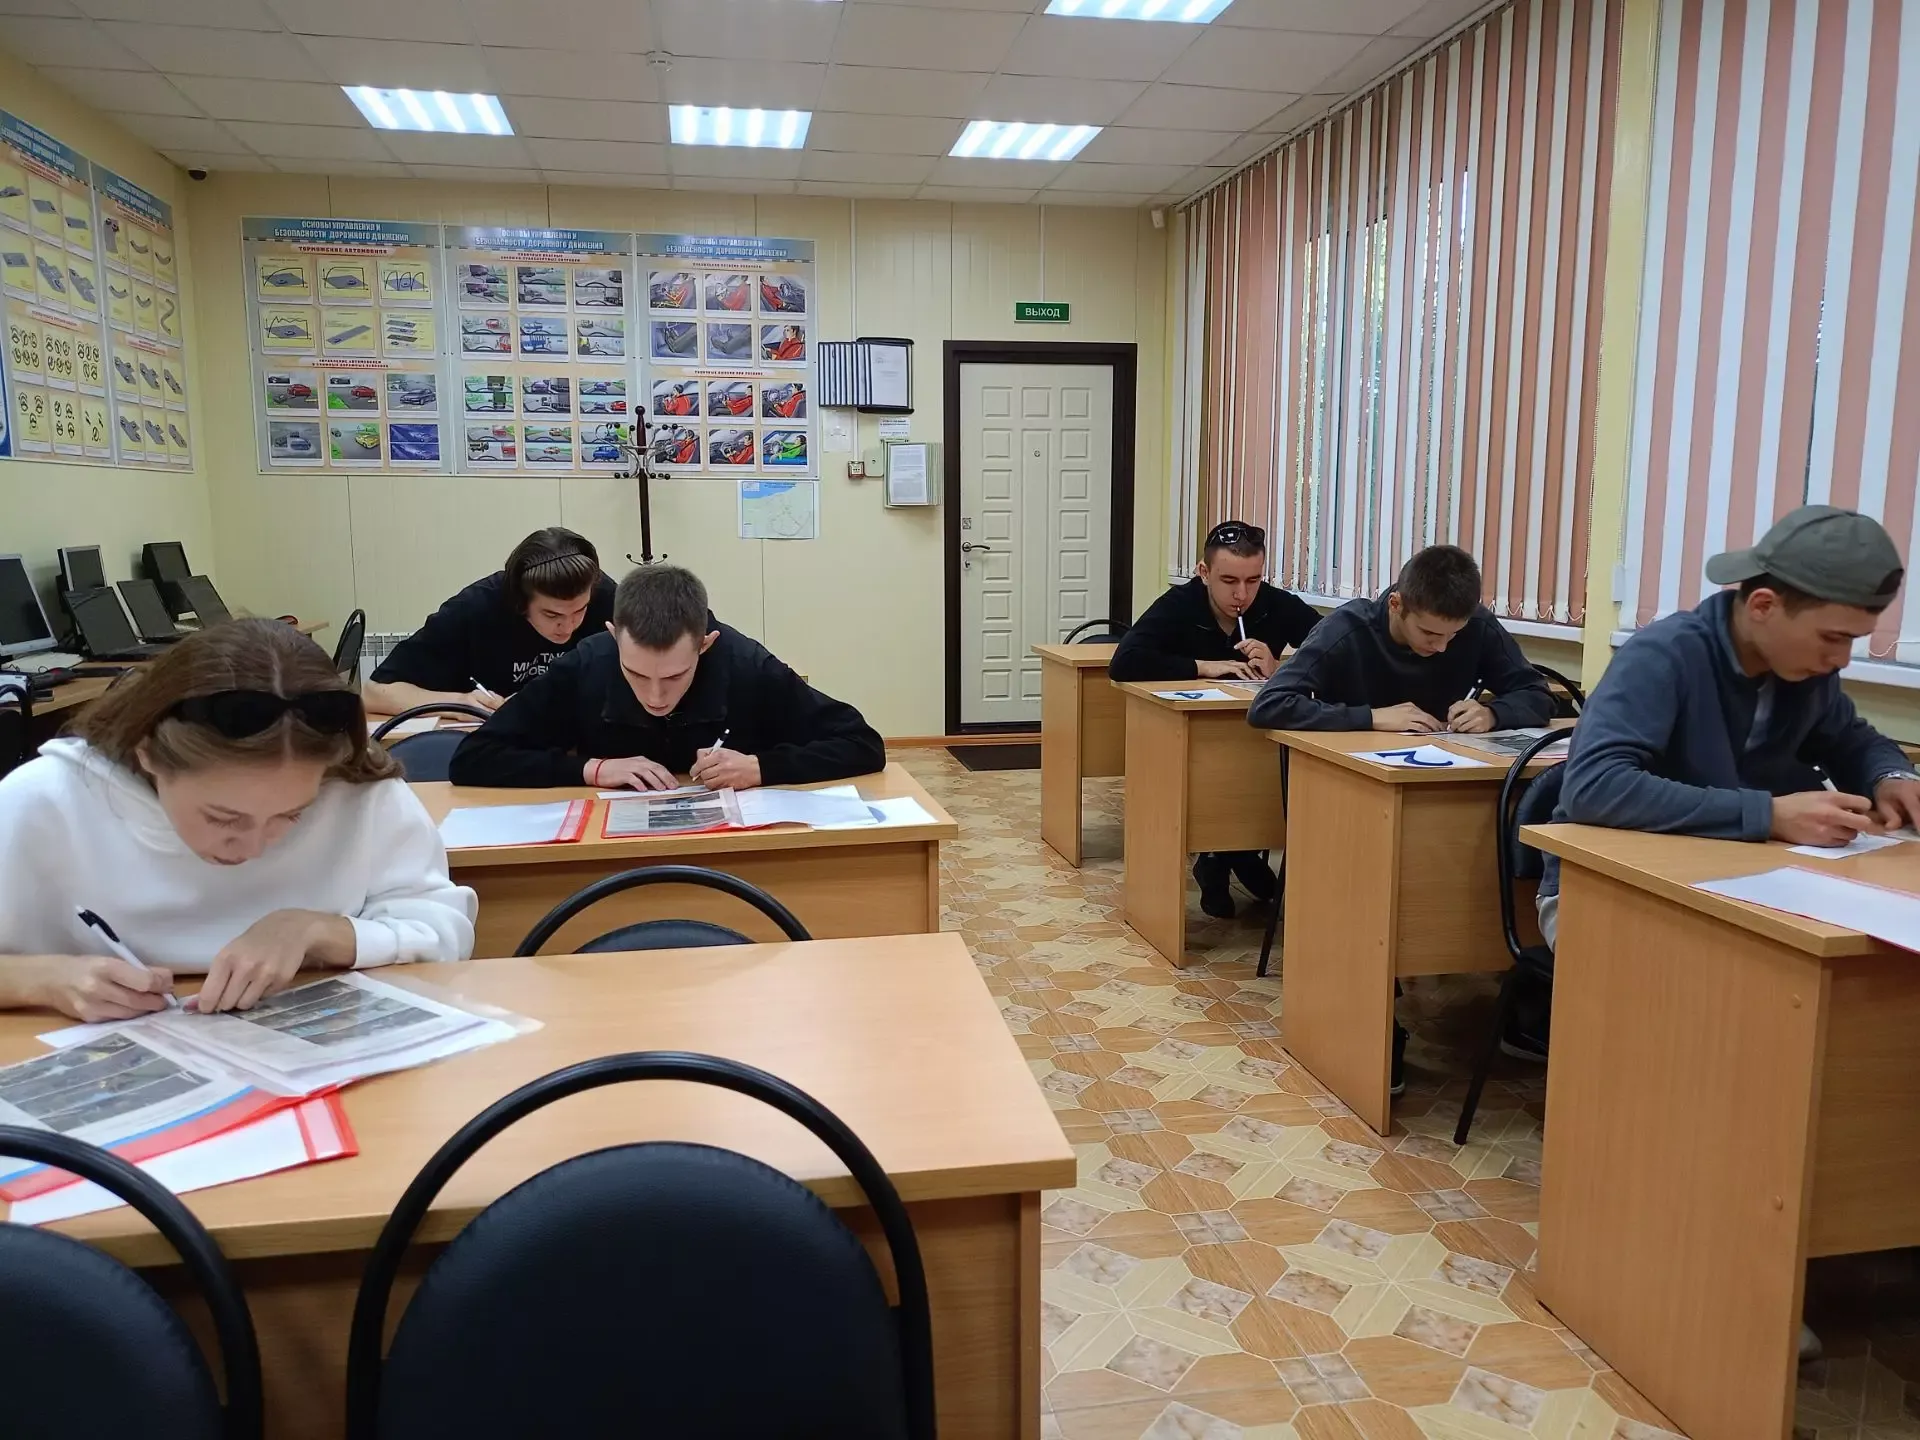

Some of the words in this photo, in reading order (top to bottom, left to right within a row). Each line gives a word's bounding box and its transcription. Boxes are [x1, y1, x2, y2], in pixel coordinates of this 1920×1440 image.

[301, 220, 331, 229] ОСНОВЫ
[331, 221, 375, 231] УПРАВЛЕНИЯ
[274, 228, 327, 238] БЕЗОПАСНОСТИ
[329, 230, 371, 240] ДОРОЖНОГО
[371, 232, 409, 242] ДВИЖЕНИЯ
[298, 245, 342, 254] ТОРМОЖЕНИЕ
[344, 247, 388, 256] АВТОМОБИЛЯ
[1025, 307, 1061, 318] ВЫХОД
[1374, 750, 1454, 767] 2
